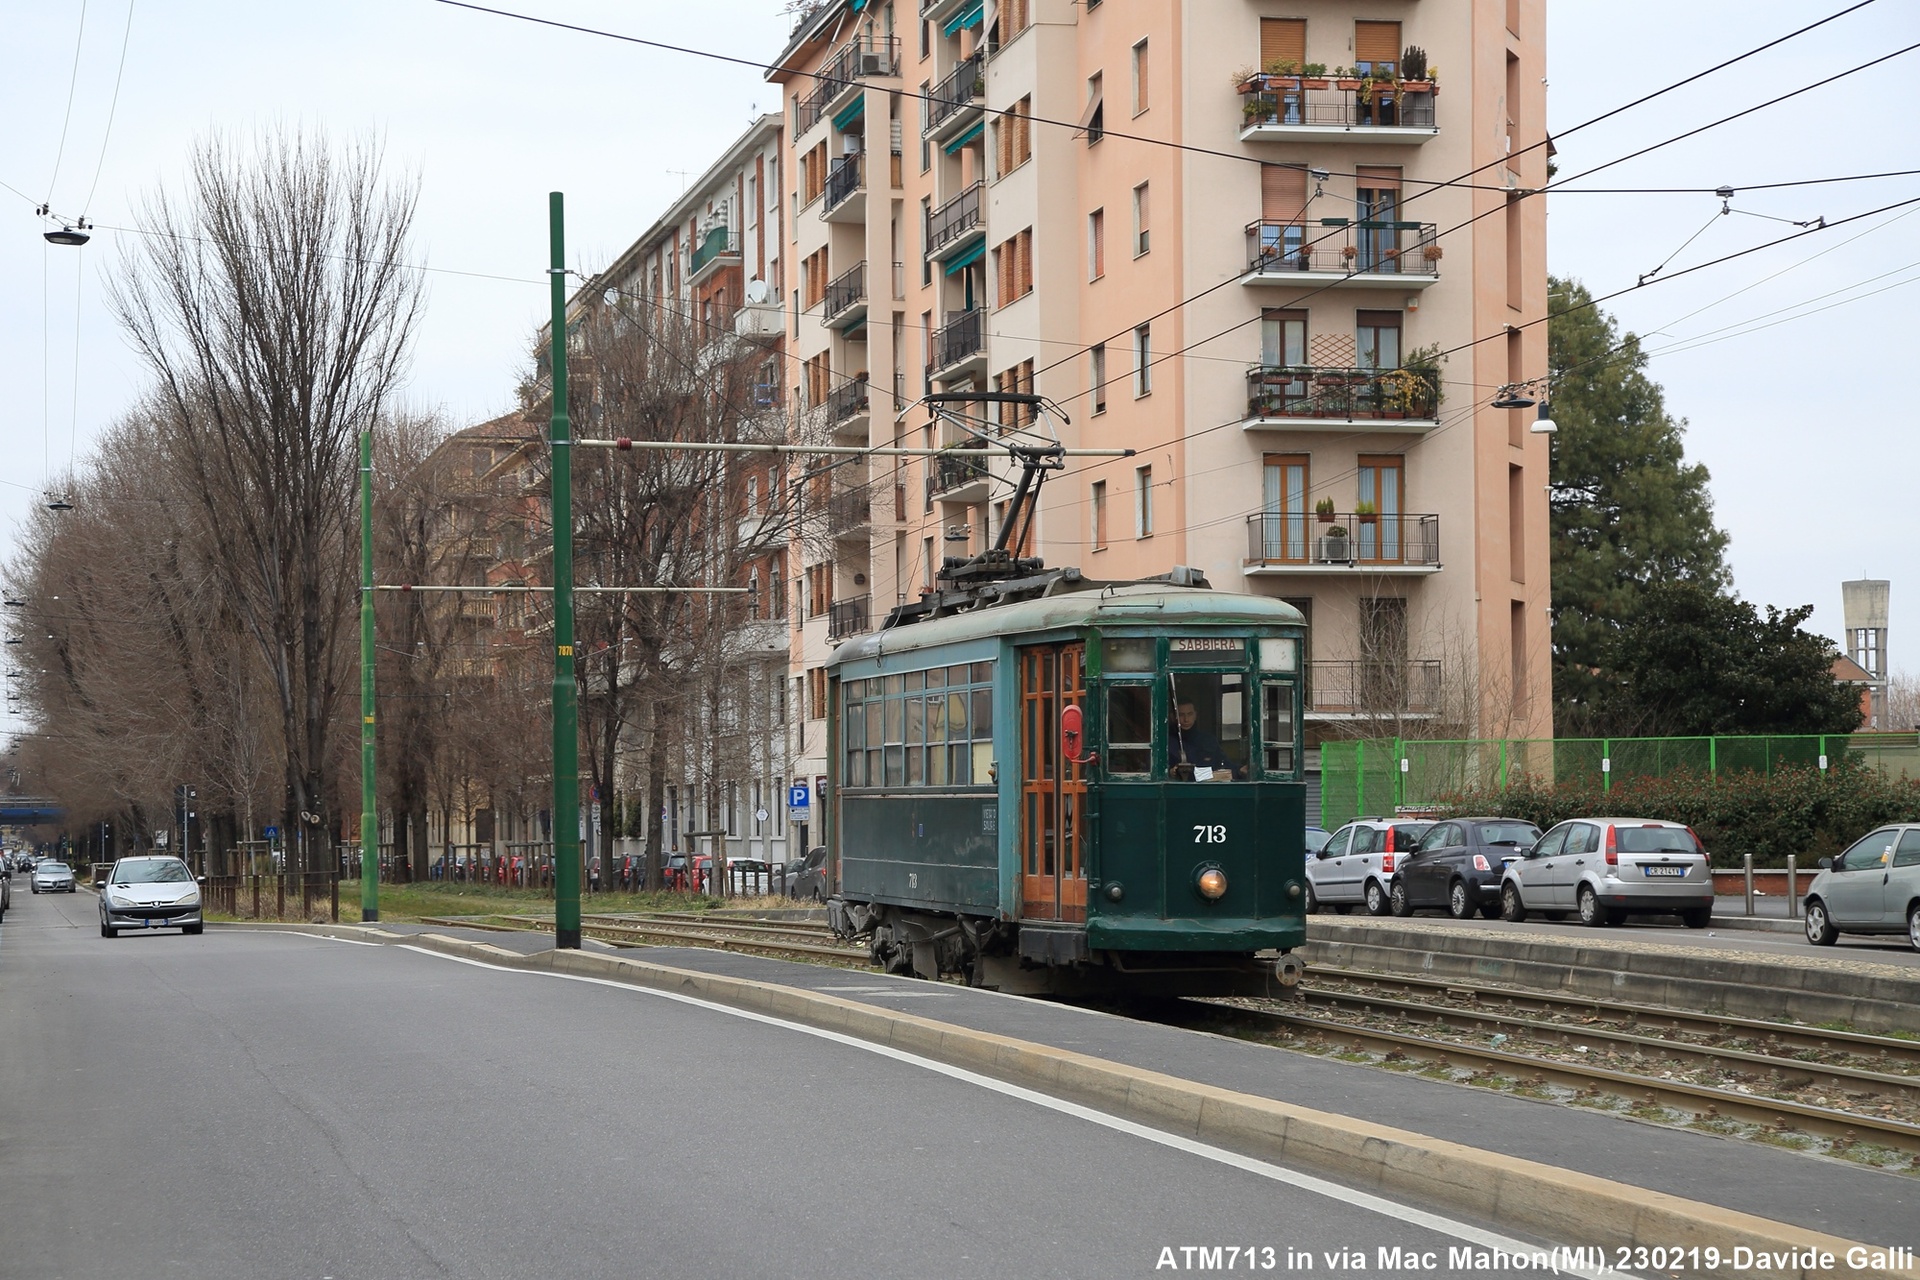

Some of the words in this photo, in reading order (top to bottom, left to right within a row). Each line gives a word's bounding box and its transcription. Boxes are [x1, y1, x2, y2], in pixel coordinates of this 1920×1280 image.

[1178, 638, 1236, 651] SABBIERA
[793, 789, 806, 805] P
[1193, 825, 1227, 843] 713
